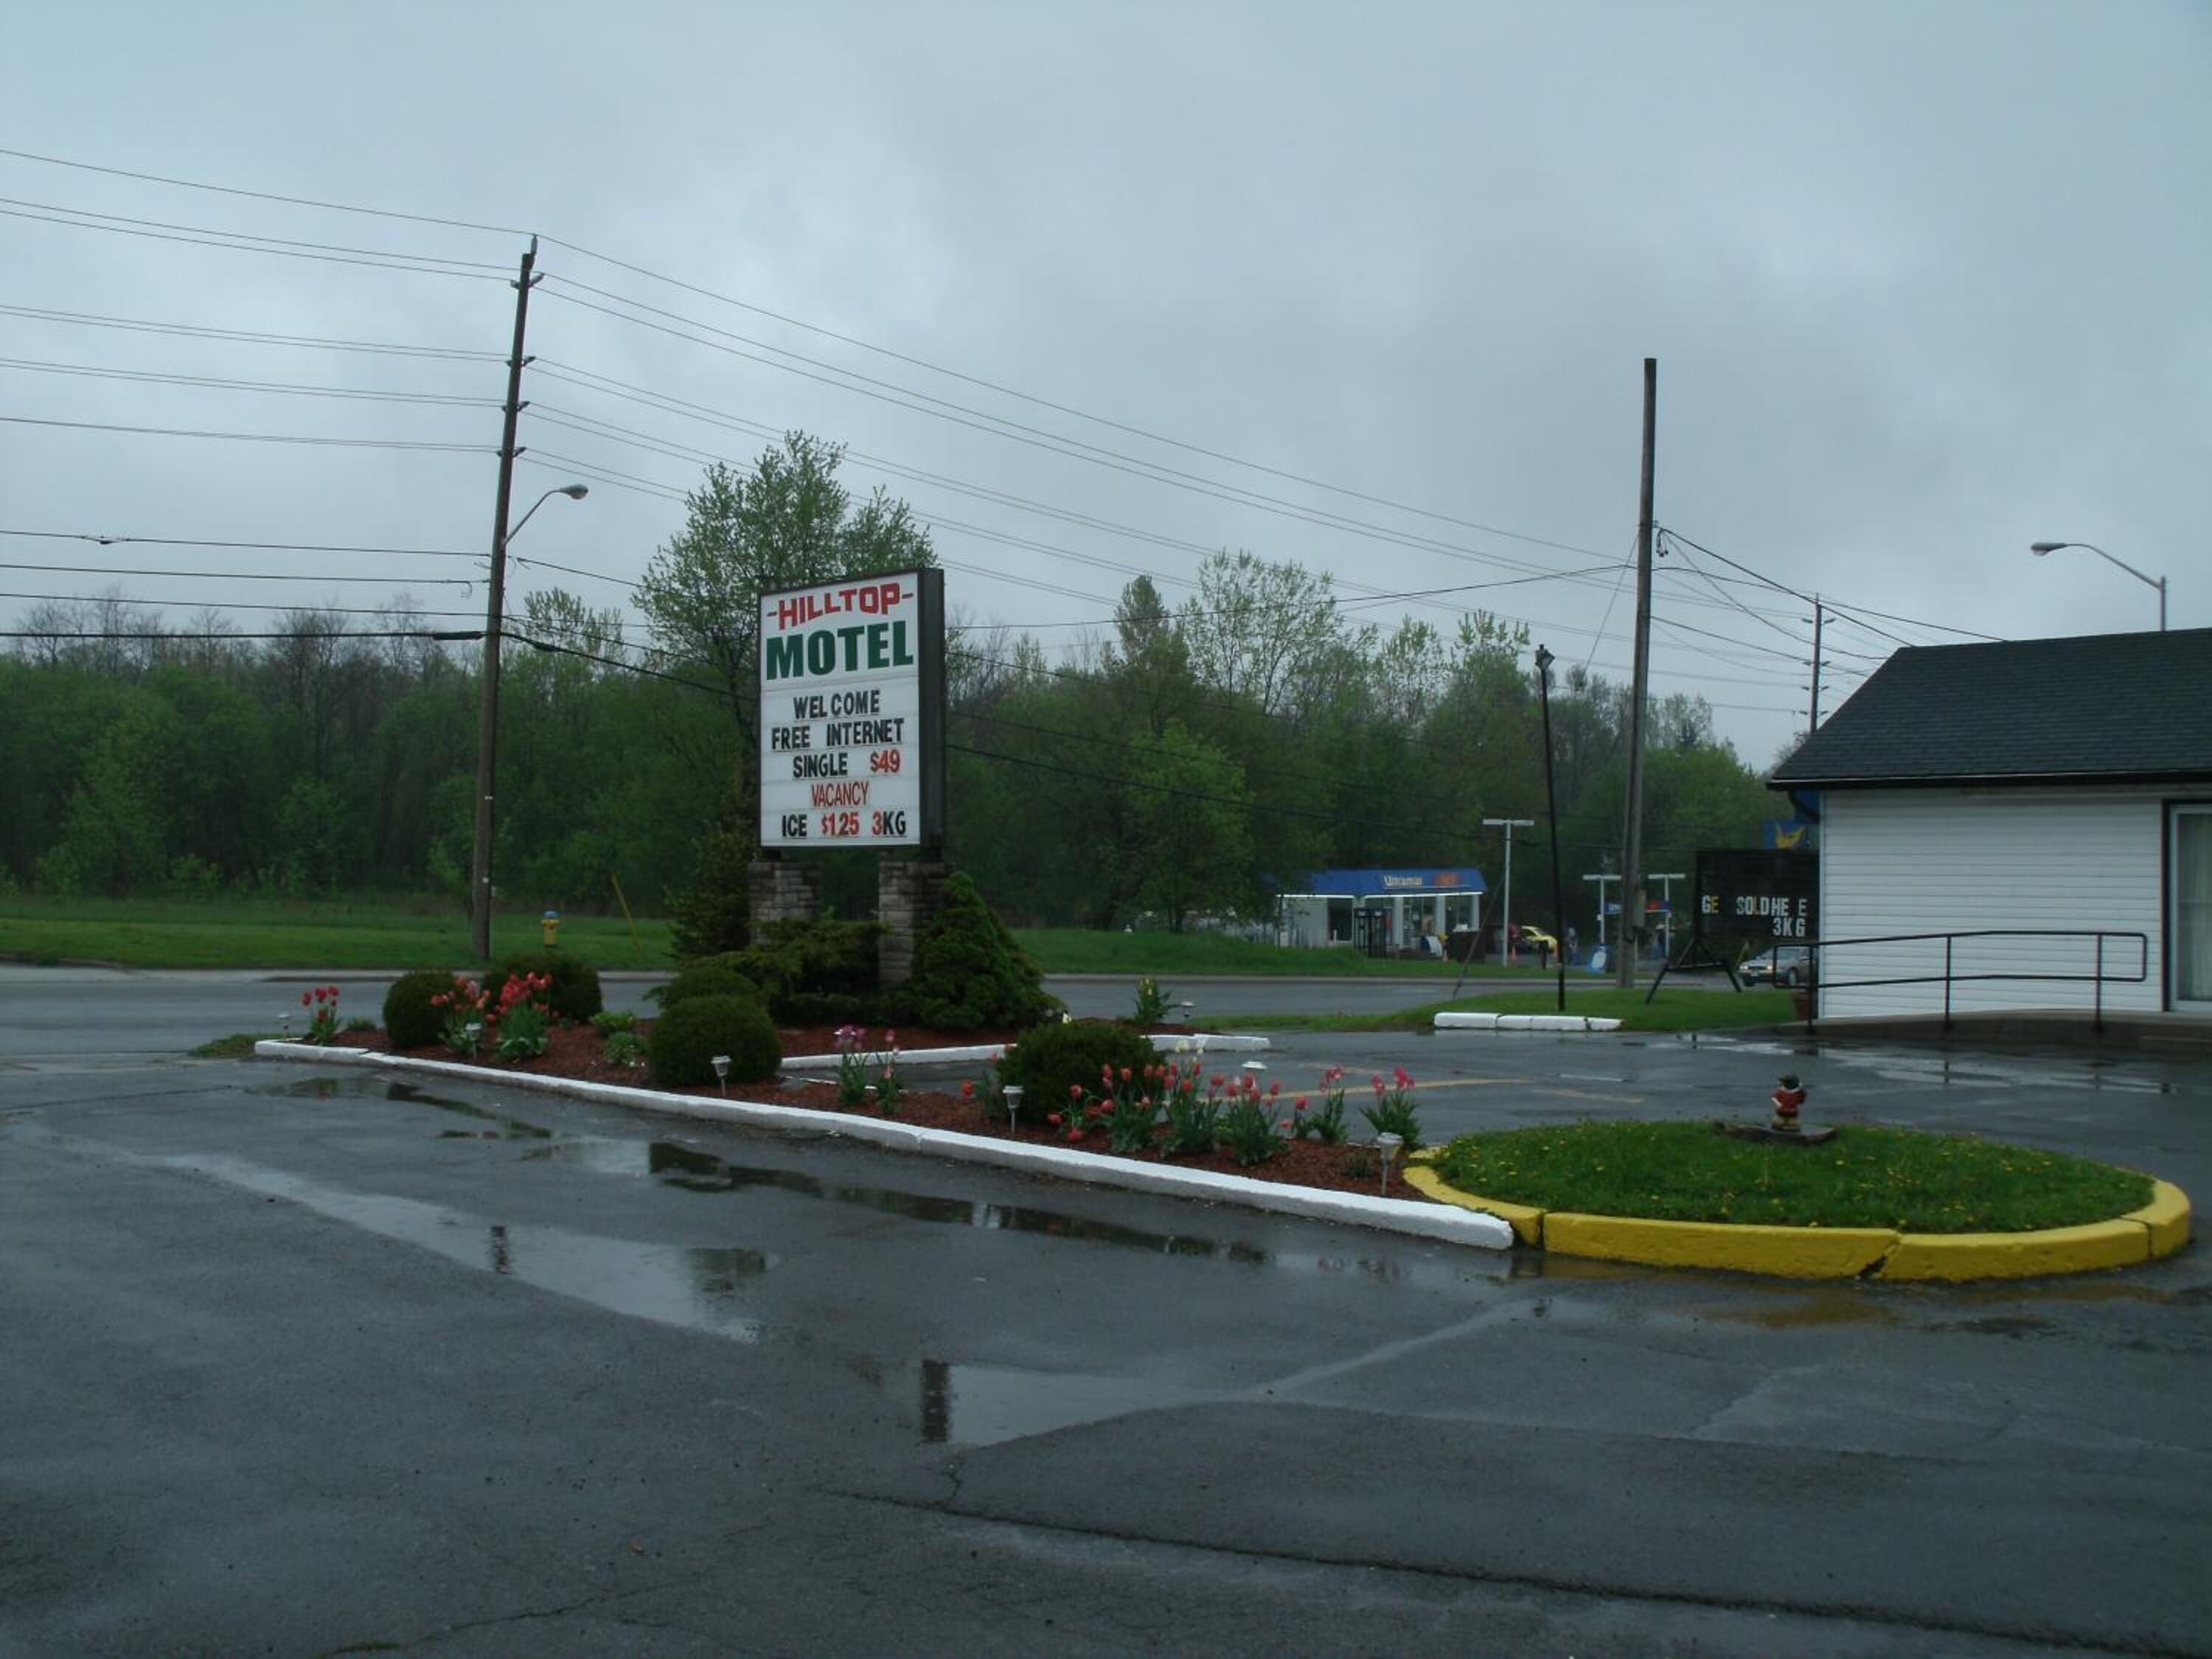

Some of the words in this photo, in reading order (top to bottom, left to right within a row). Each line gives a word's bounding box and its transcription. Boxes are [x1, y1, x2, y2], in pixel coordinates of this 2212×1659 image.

[766, 621, 914, 680] MOTEL
[772, 726, 810, 749] FREE
[827, 718, 904, 746] INTERNET
[793, 753, 848, 778] SINGLE
[870, 749, 900, 773] $49
[812, 781, 869, 807] VACANCY
[782, 814, 807, 837] ICE
[872, 810, 906, 835] 3KG
[1701, 894, 1719, 914] GE
